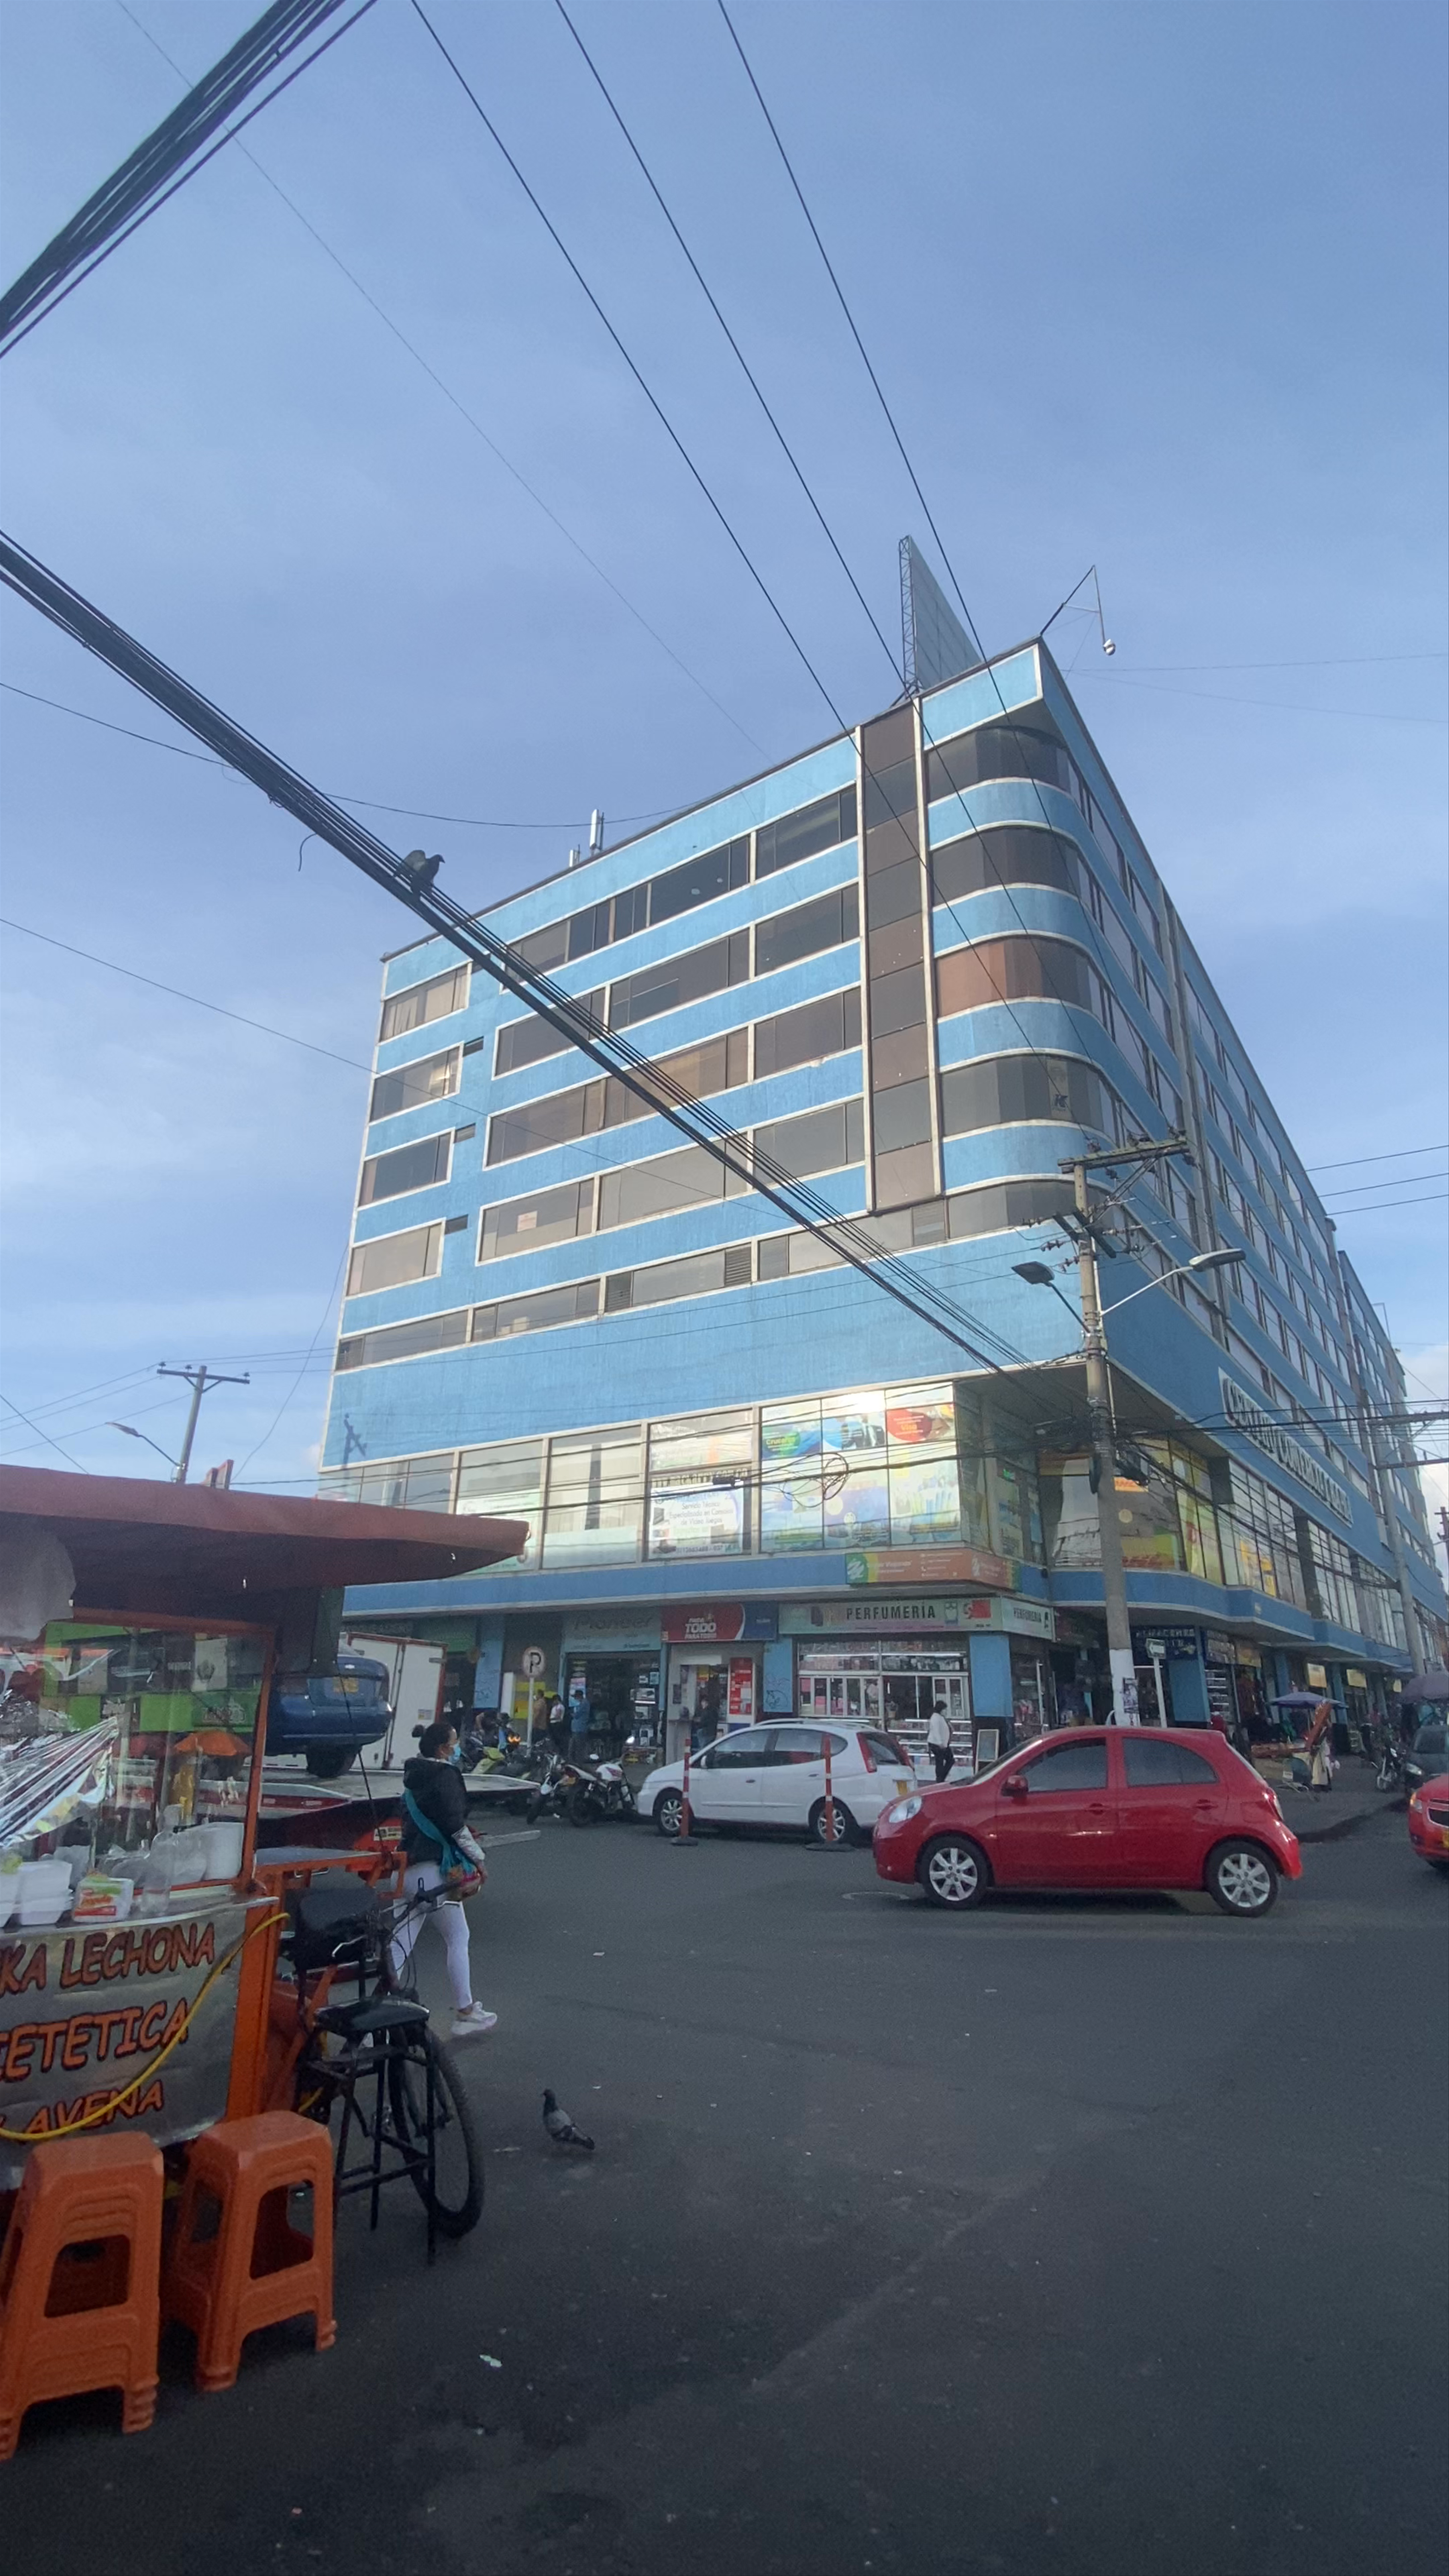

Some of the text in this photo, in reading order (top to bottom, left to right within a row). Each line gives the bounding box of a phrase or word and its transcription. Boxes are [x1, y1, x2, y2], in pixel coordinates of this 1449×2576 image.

[685, 1623, 717, 1633] TODO
[530, 1652, 541, 1673] P
[59, 1921, 215, 1989] LECHONA
[23, 2079, 164, 2144] AVENA
